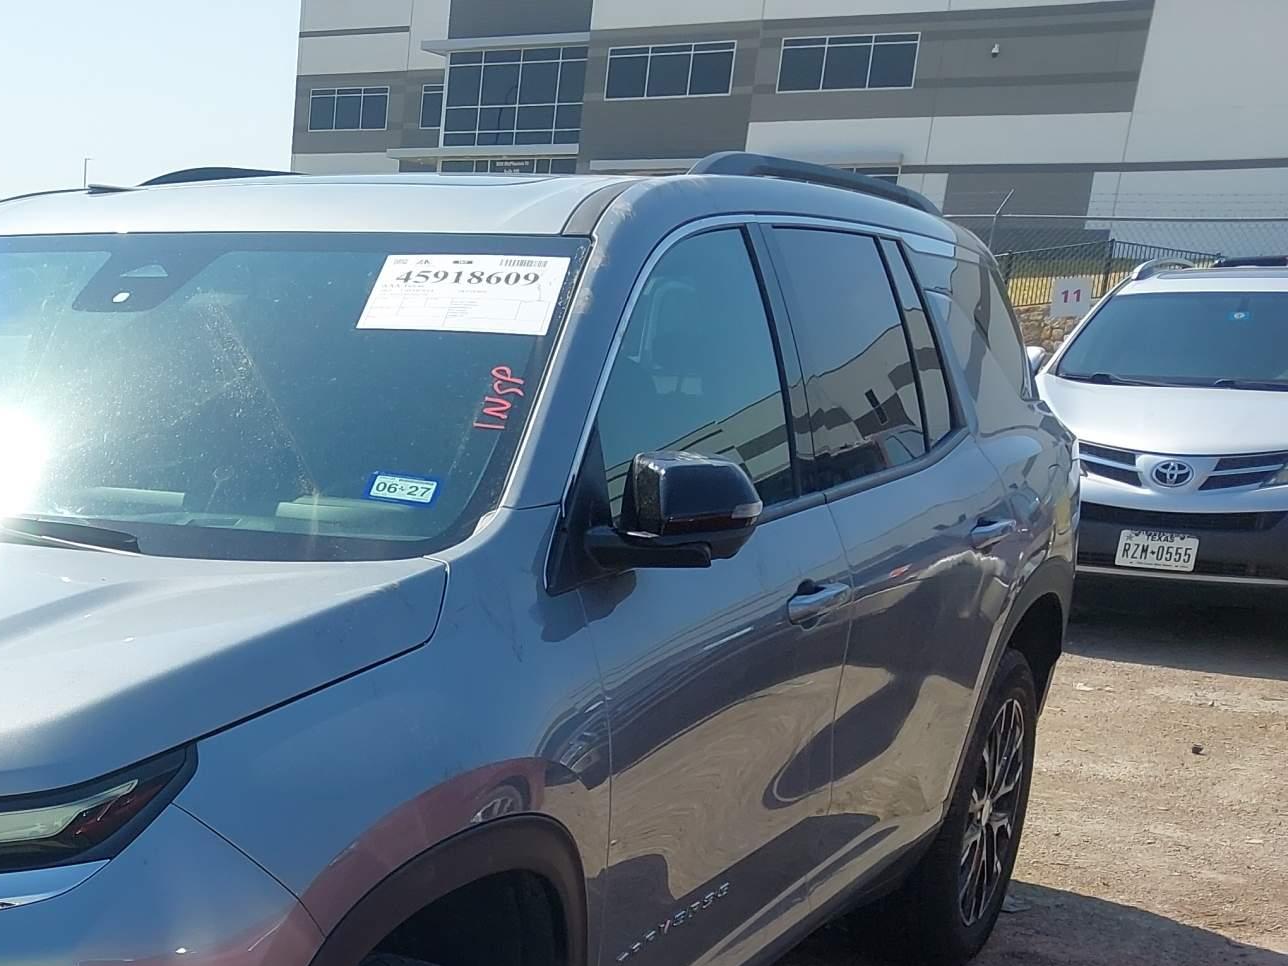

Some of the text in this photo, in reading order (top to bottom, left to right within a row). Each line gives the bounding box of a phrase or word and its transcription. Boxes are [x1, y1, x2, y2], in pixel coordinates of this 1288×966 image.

[395, 269, 540, 287] 45918609
[1061, 289, 1081, 303] 11
[1146, 534, 1175, 543] TEXAS
